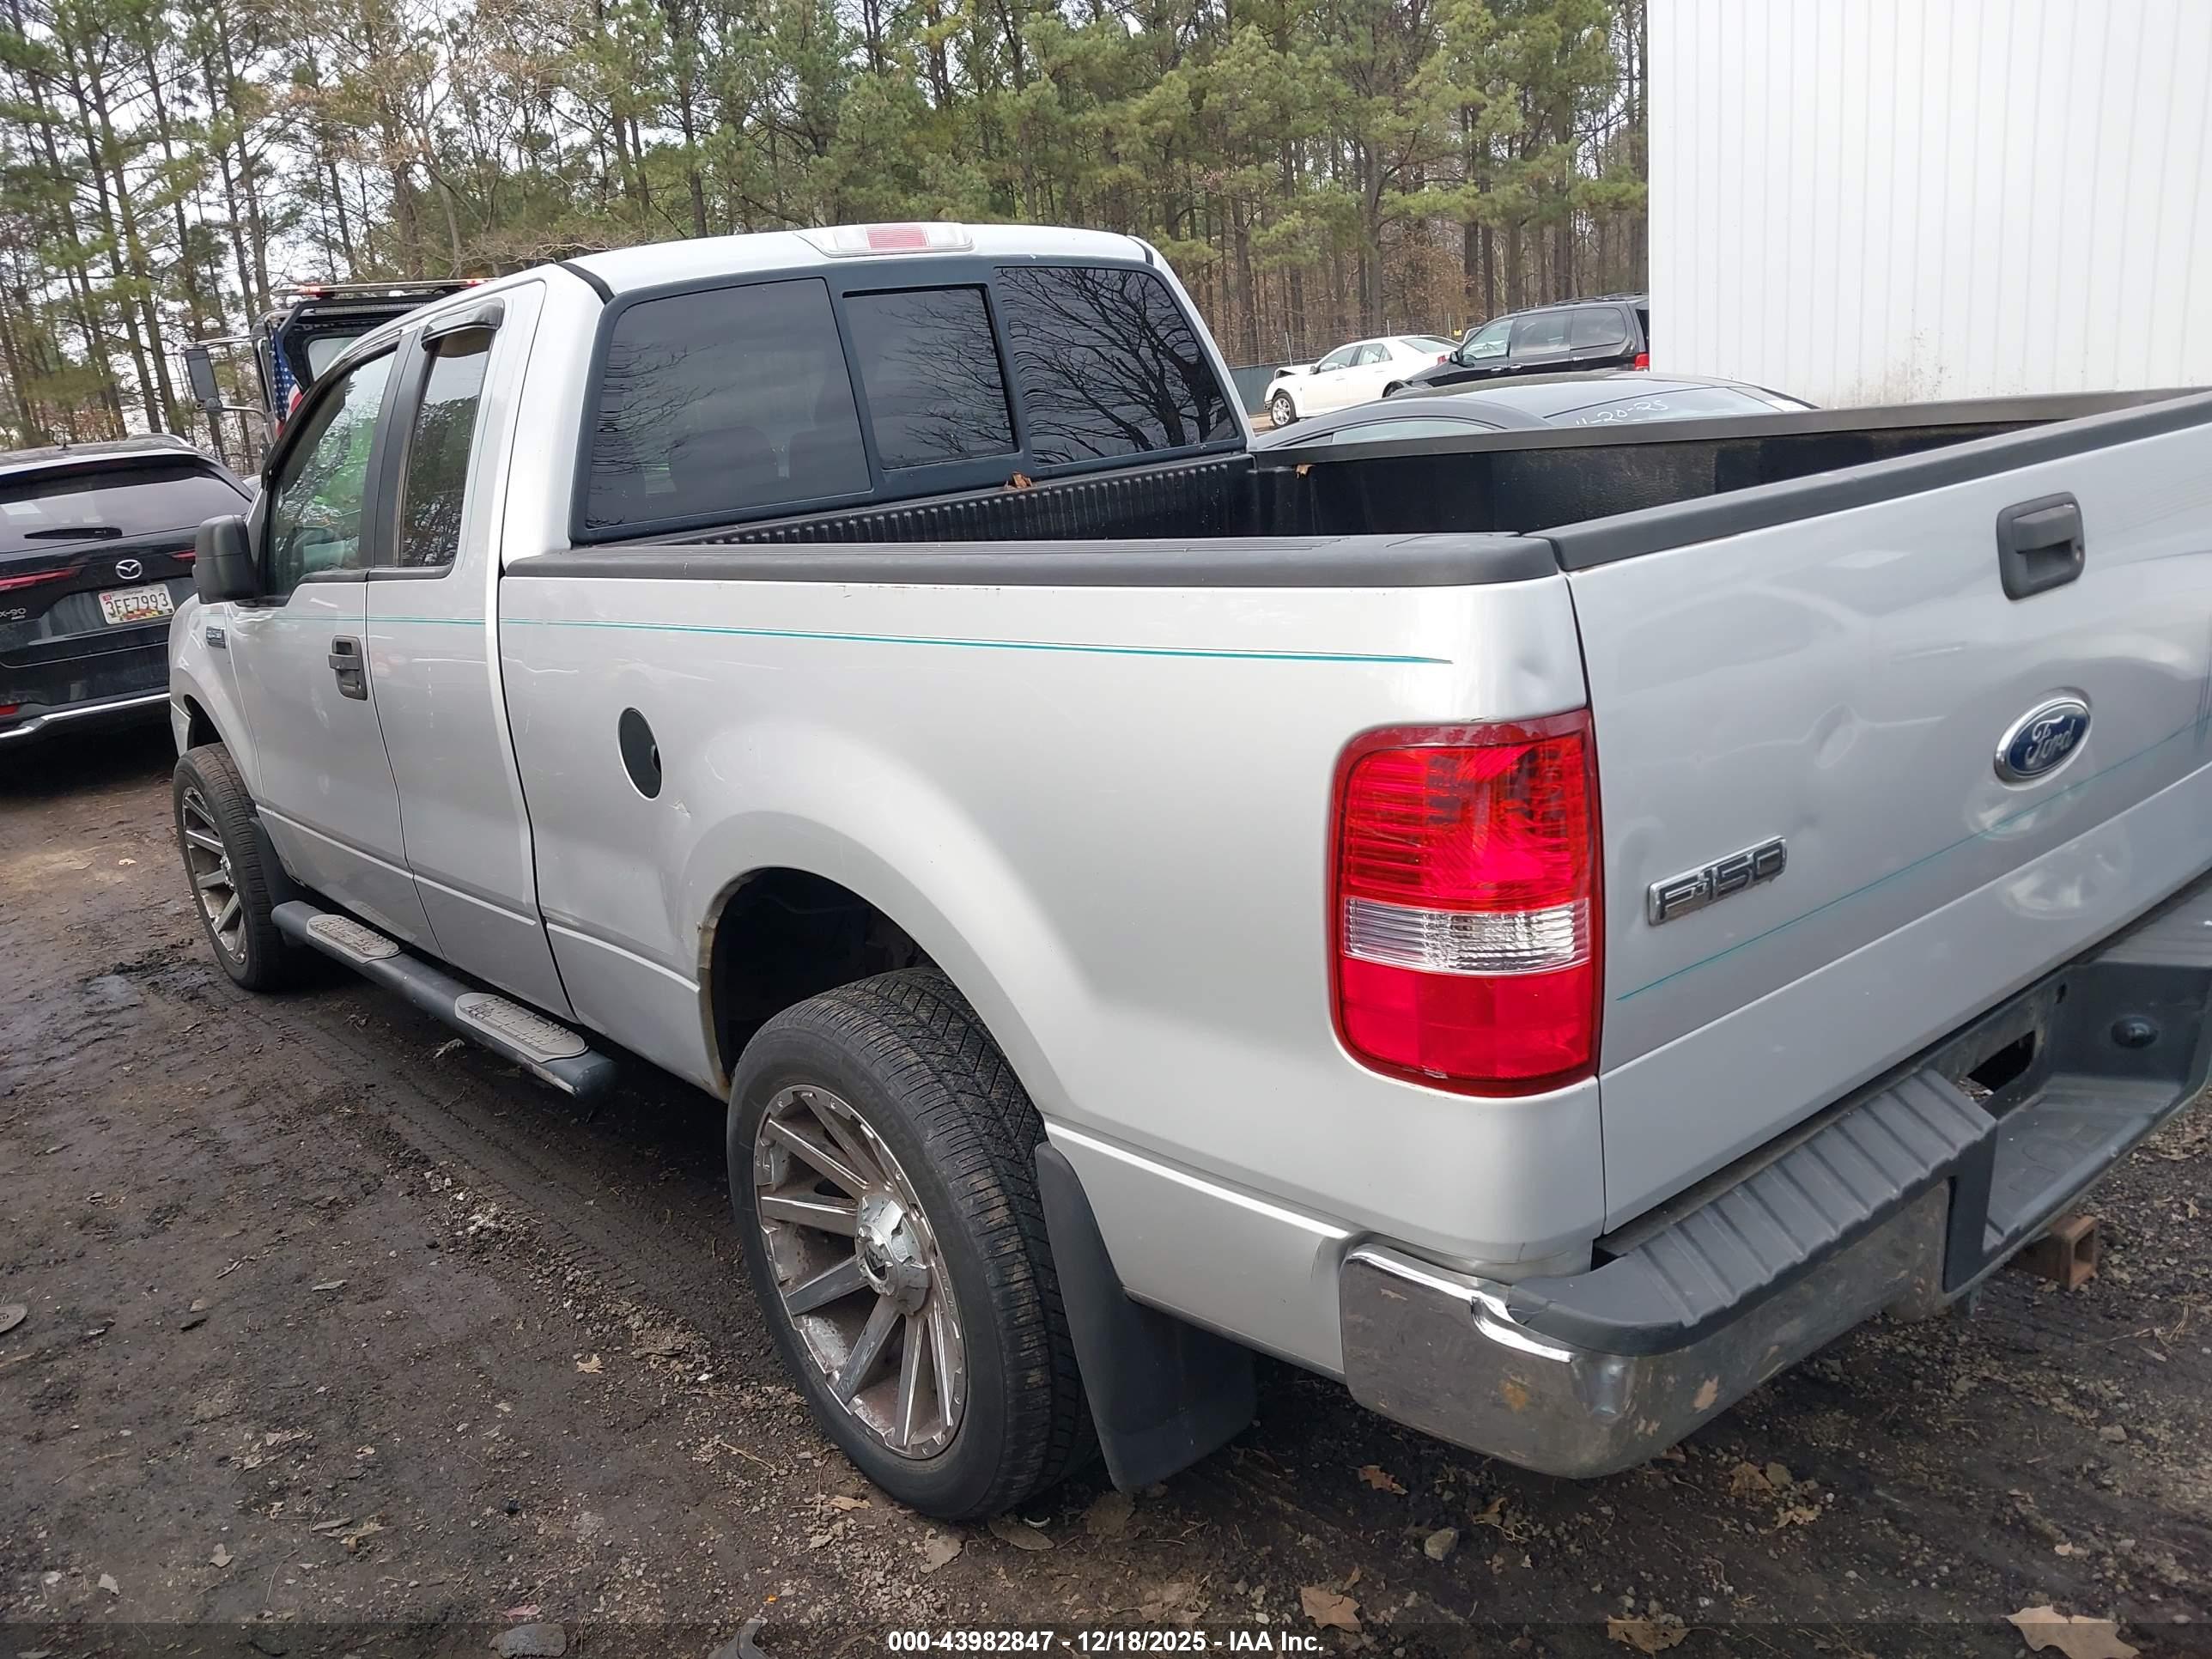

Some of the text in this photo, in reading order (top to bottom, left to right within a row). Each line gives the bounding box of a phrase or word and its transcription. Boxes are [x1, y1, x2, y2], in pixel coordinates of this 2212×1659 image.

[105, 592, 169, 617] 3FE7993
[2024, 714, 2076, 766] Ford
[1657, 838, 1786, 921] F-150
